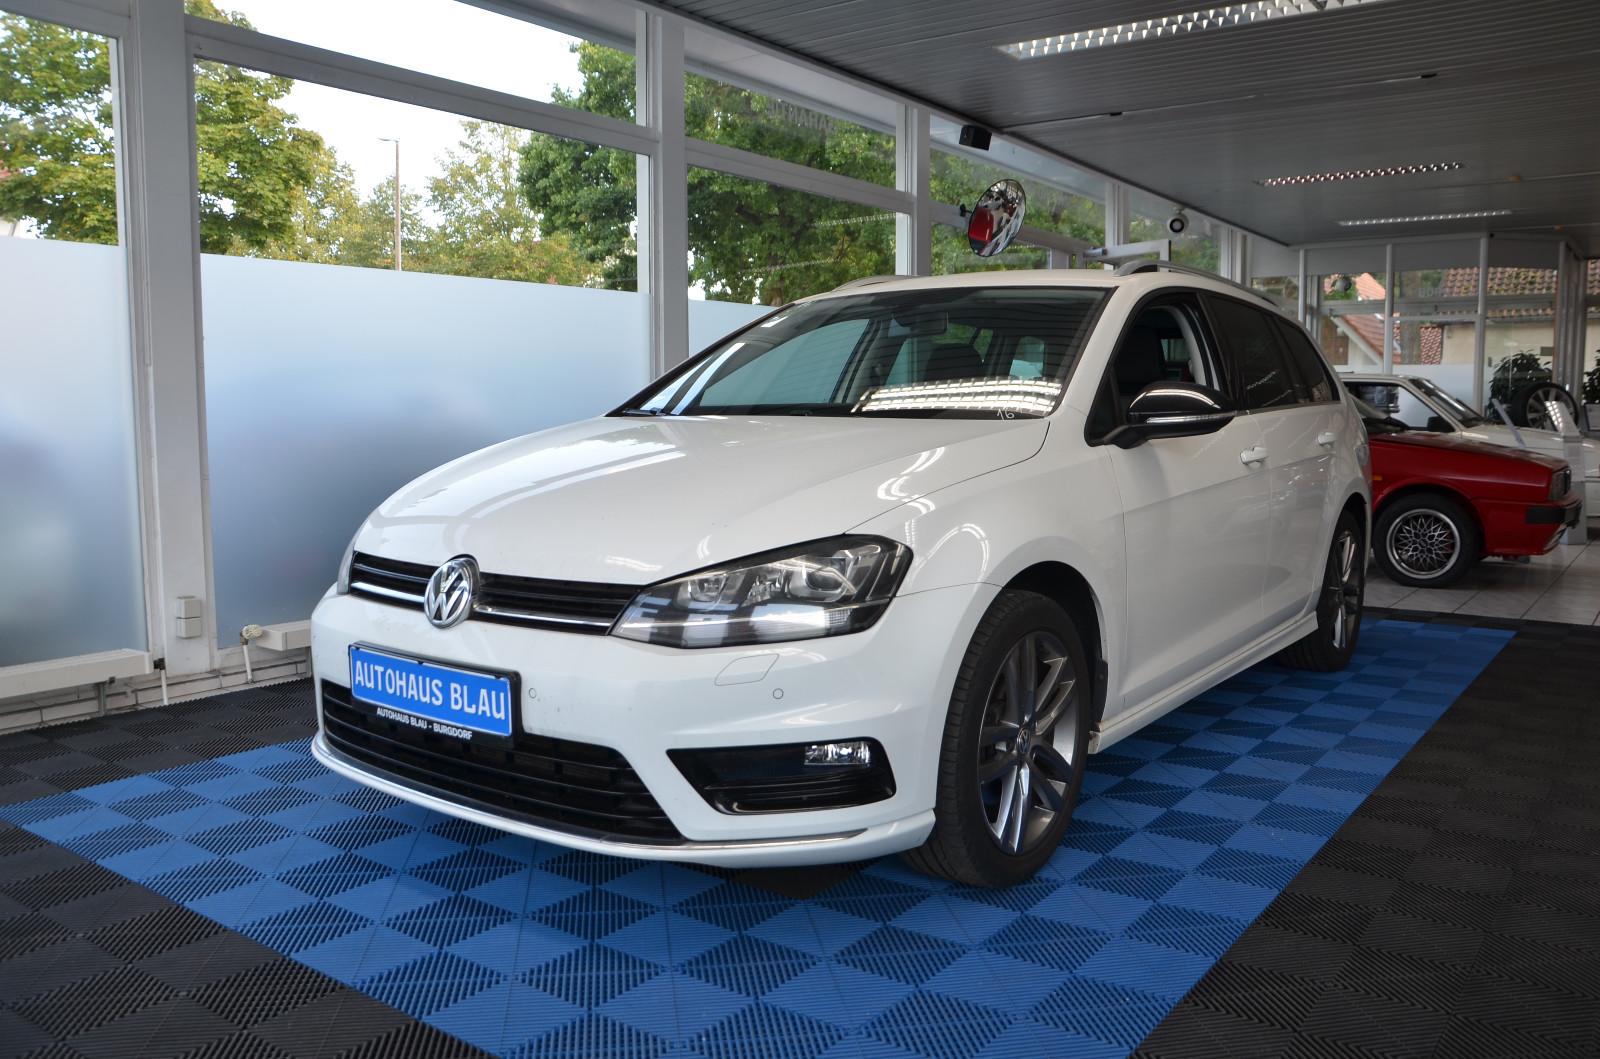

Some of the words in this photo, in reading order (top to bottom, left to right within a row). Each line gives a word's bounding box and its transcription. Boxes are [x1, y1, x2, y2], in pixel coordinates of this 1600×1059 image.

[355, 660, 443, 706] AUTOHAUS
[450, 682, 506, 720] BLAU
[377, 707, 409, 724] AUTOHAUS
[410, 717, 428, 729] BLAU
[433, 722, 473, 740] BURGDORF
